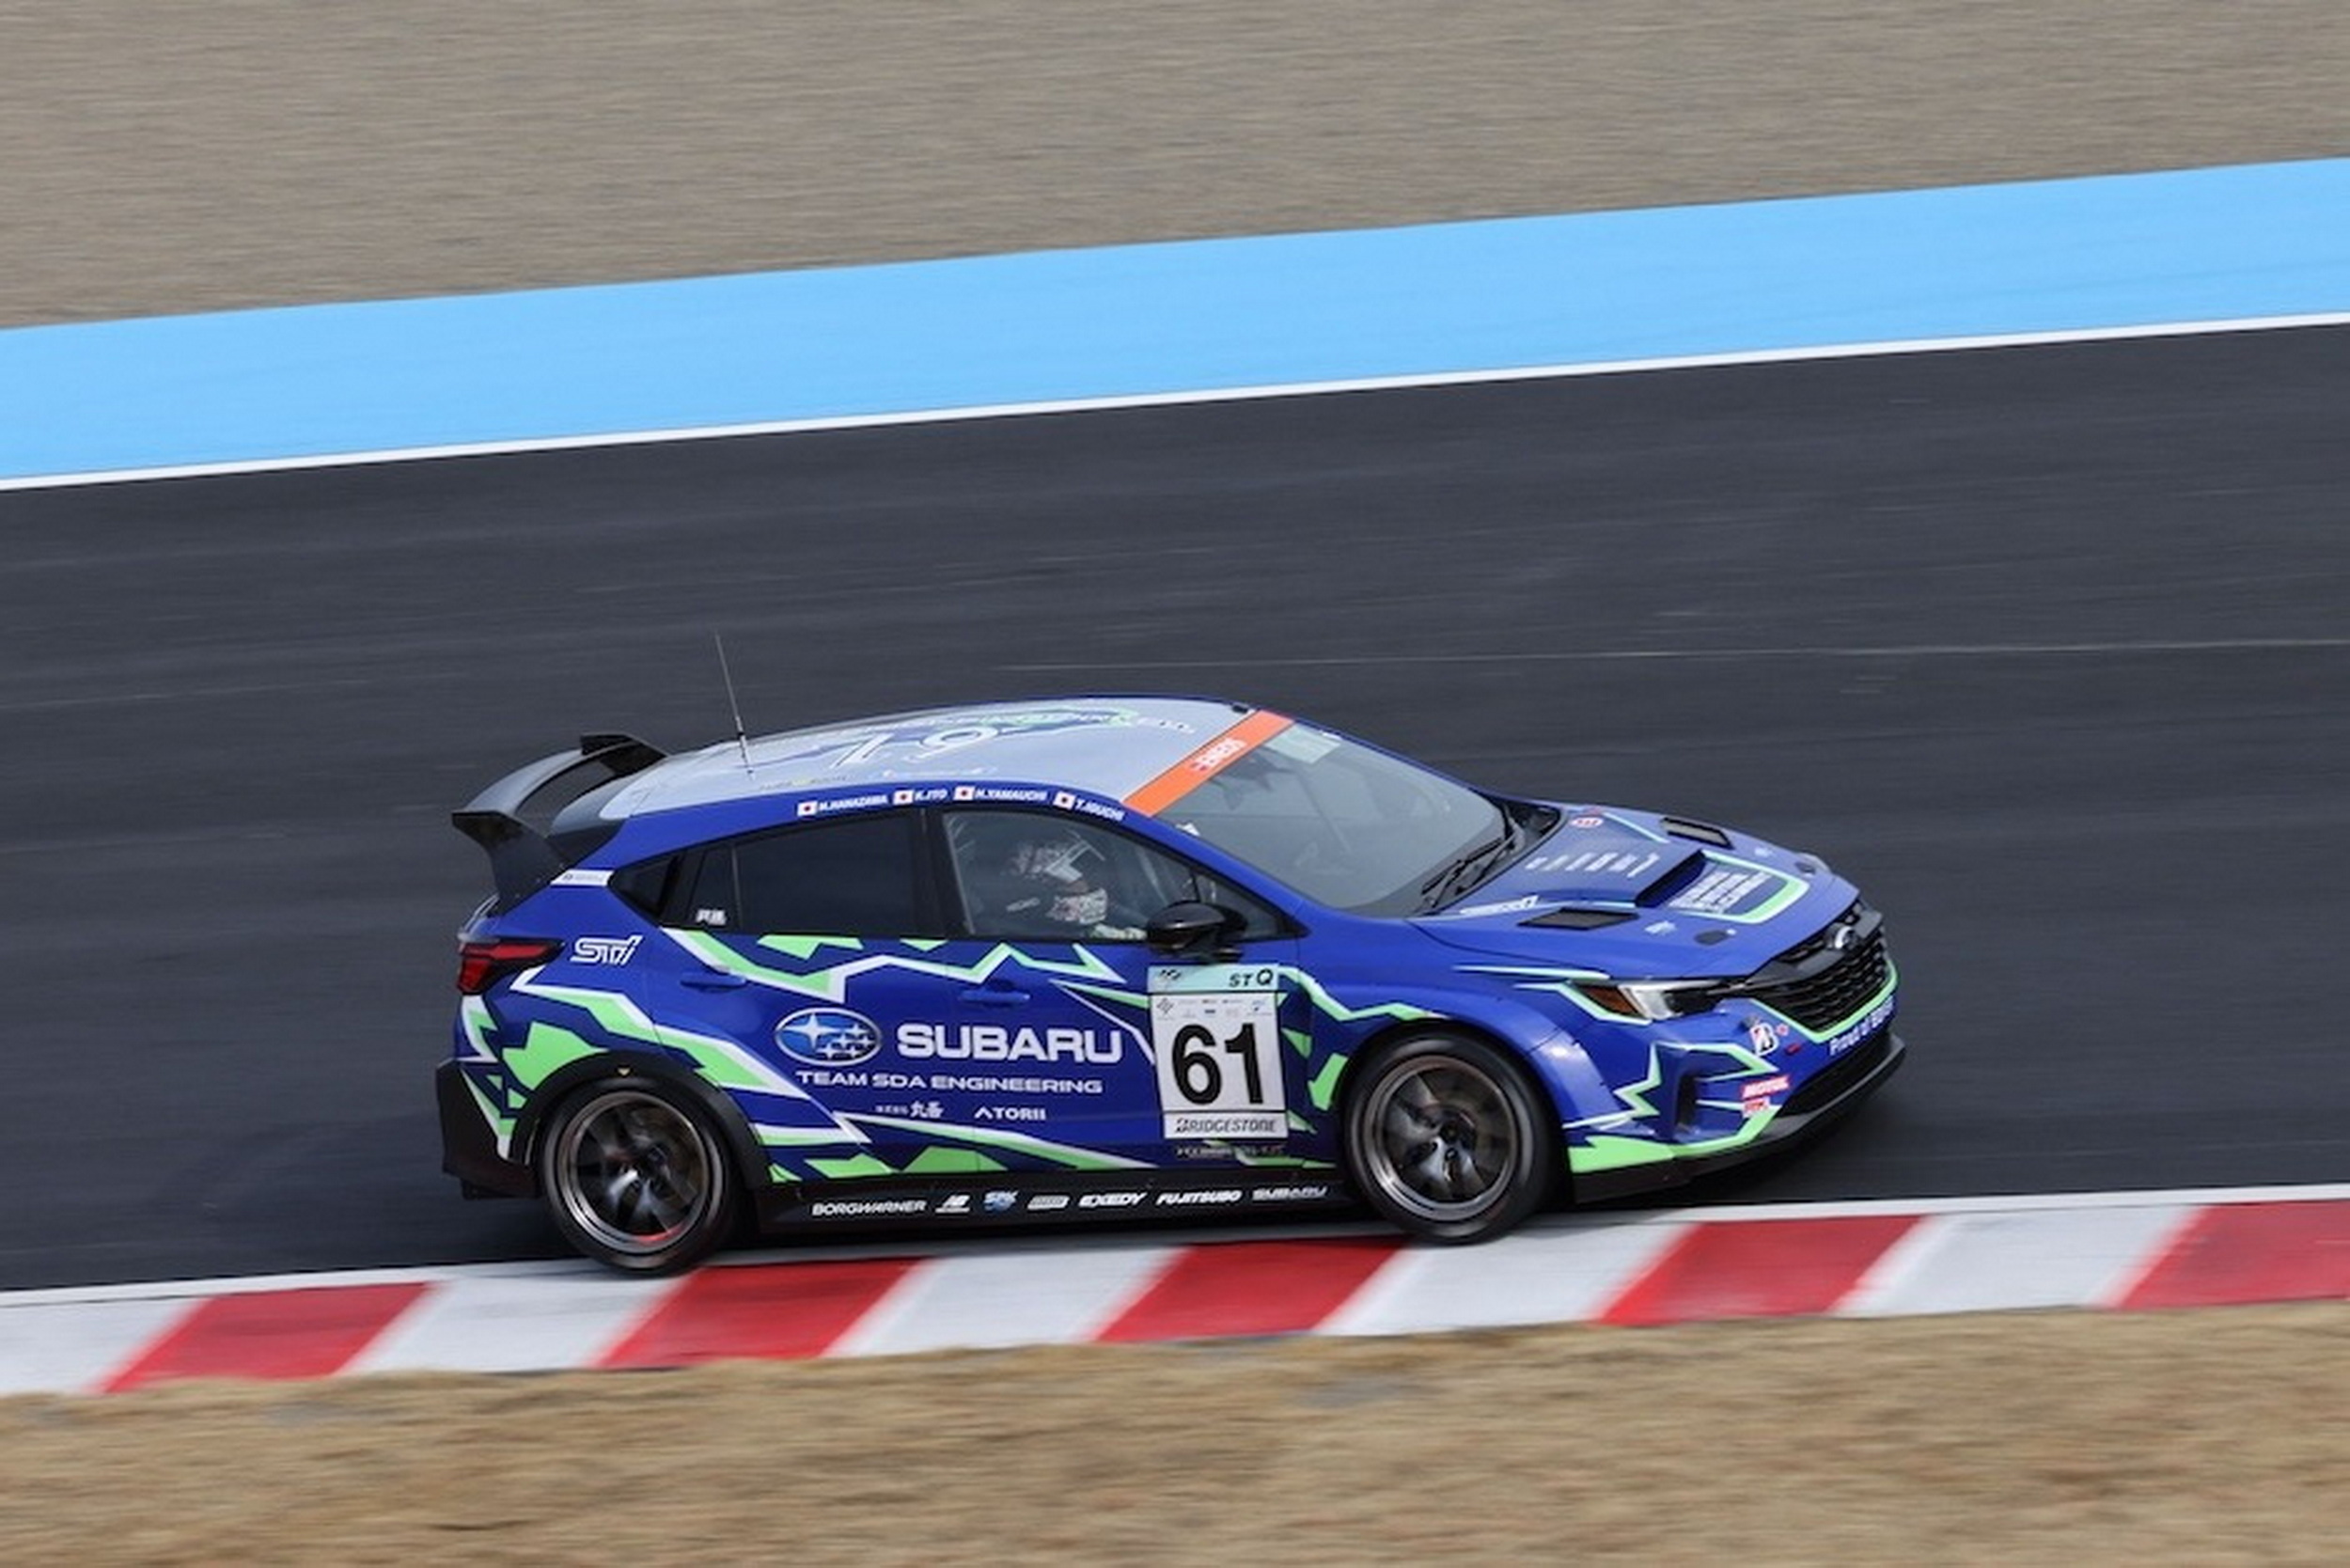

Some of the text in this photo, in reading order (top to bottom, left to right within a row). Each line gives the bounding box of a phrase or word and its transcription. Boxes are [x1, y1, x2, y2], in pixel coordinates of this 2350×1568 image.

[896, 1024, 1122, 1063] SUBARU
[1172, 1023, 1263, 1105] 61
[796, 1071, 1103, 1094] TEAM SDA ENGINEERING
[1175, 1117, 1277, 1134] BRIDGESTONE
[1078, 1192, 1147, 1208] EXEDY
[1155, 1190, 1243, 1206] FUJITSUBO
[1252, 1186, 1328, 1201] SUBARU
[811, 1200, 928, 1216] BORGWARNER
